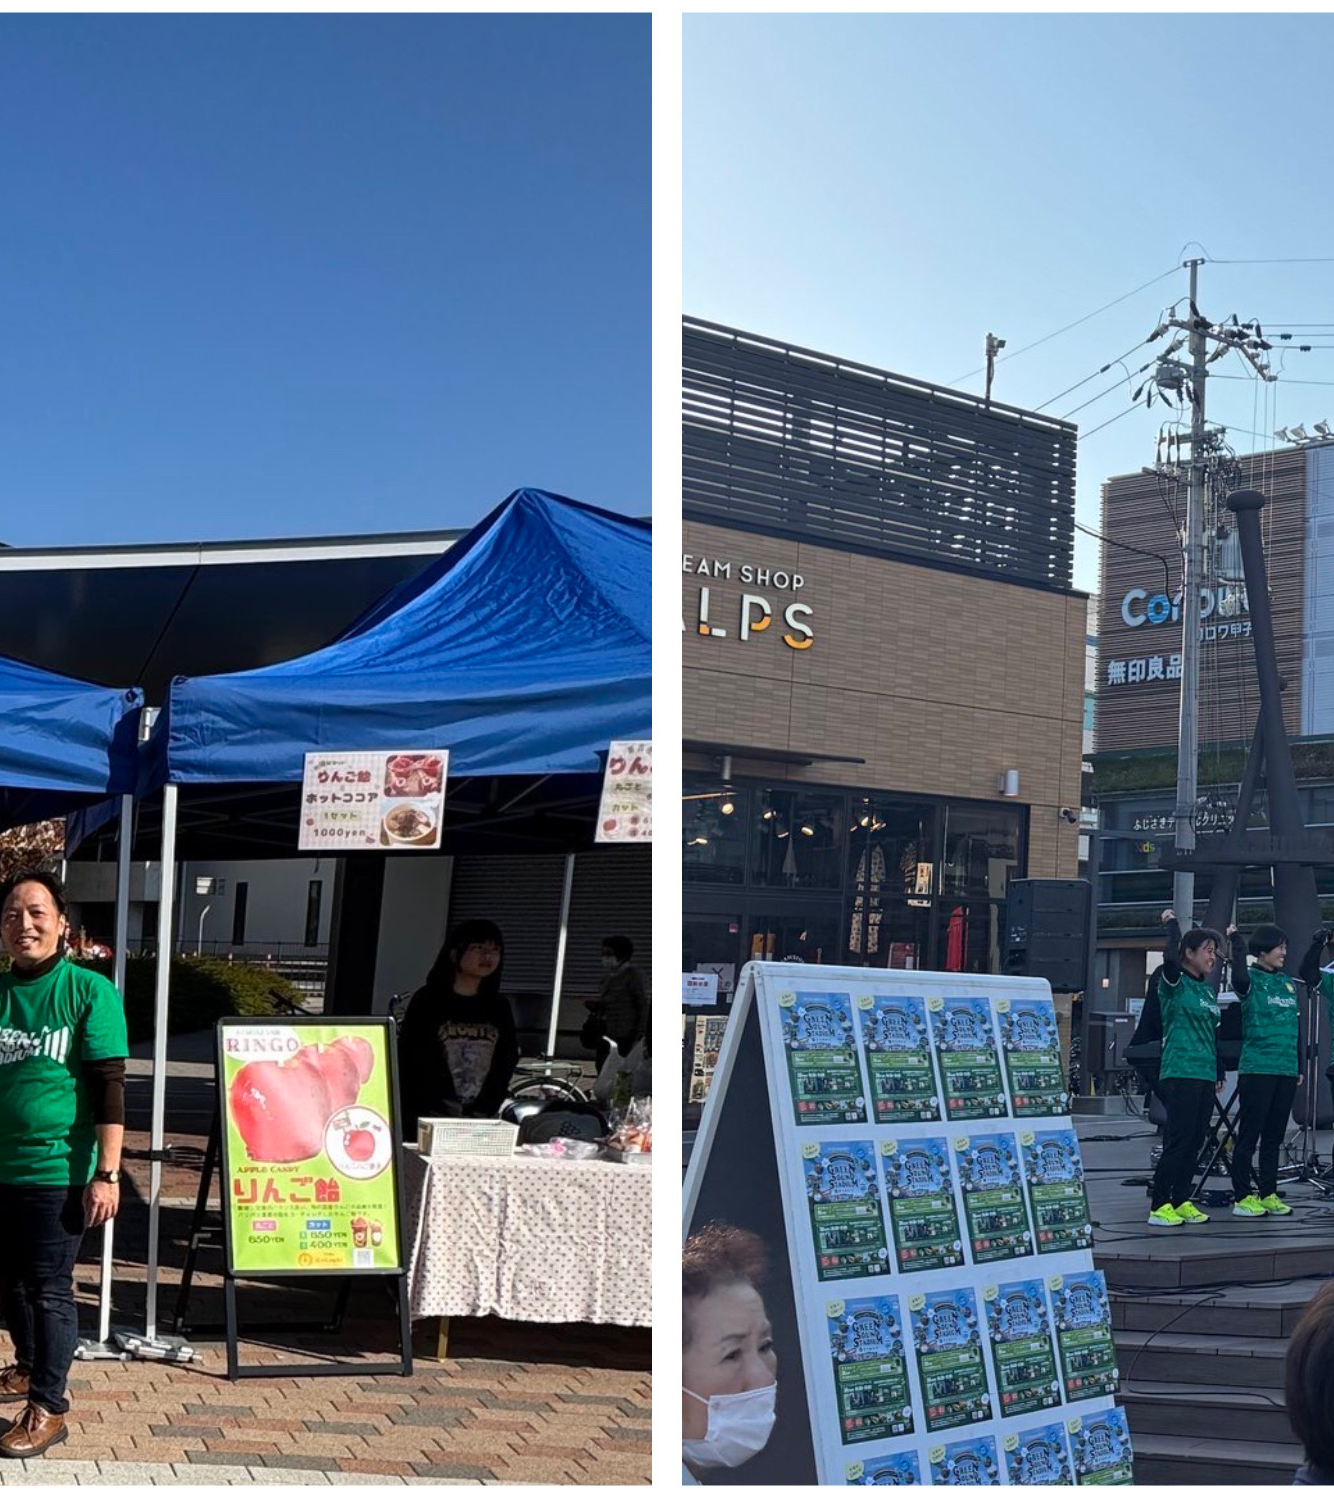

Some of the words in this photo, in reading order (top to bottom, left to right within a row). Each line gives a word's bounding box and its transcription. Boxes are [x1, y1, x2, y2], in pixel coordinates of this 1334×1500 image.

[682, 554, 731, 579] EAM
[739, 564, 805, 592] SHOP
[682, 585, 815, 650] LPS
[1198, 621, 1253, 642] ロワ甲子
[1107, 654, 1184, 686] 無印良品
[609, 755, 652, 775] りん
[306, 791, 379, 804] ホットココア
[226, 1037, 300, 1052] RINGO
[237, 1166, 267, 1174] APPLE
[233, 1176, 340, 1204] りんご飴
